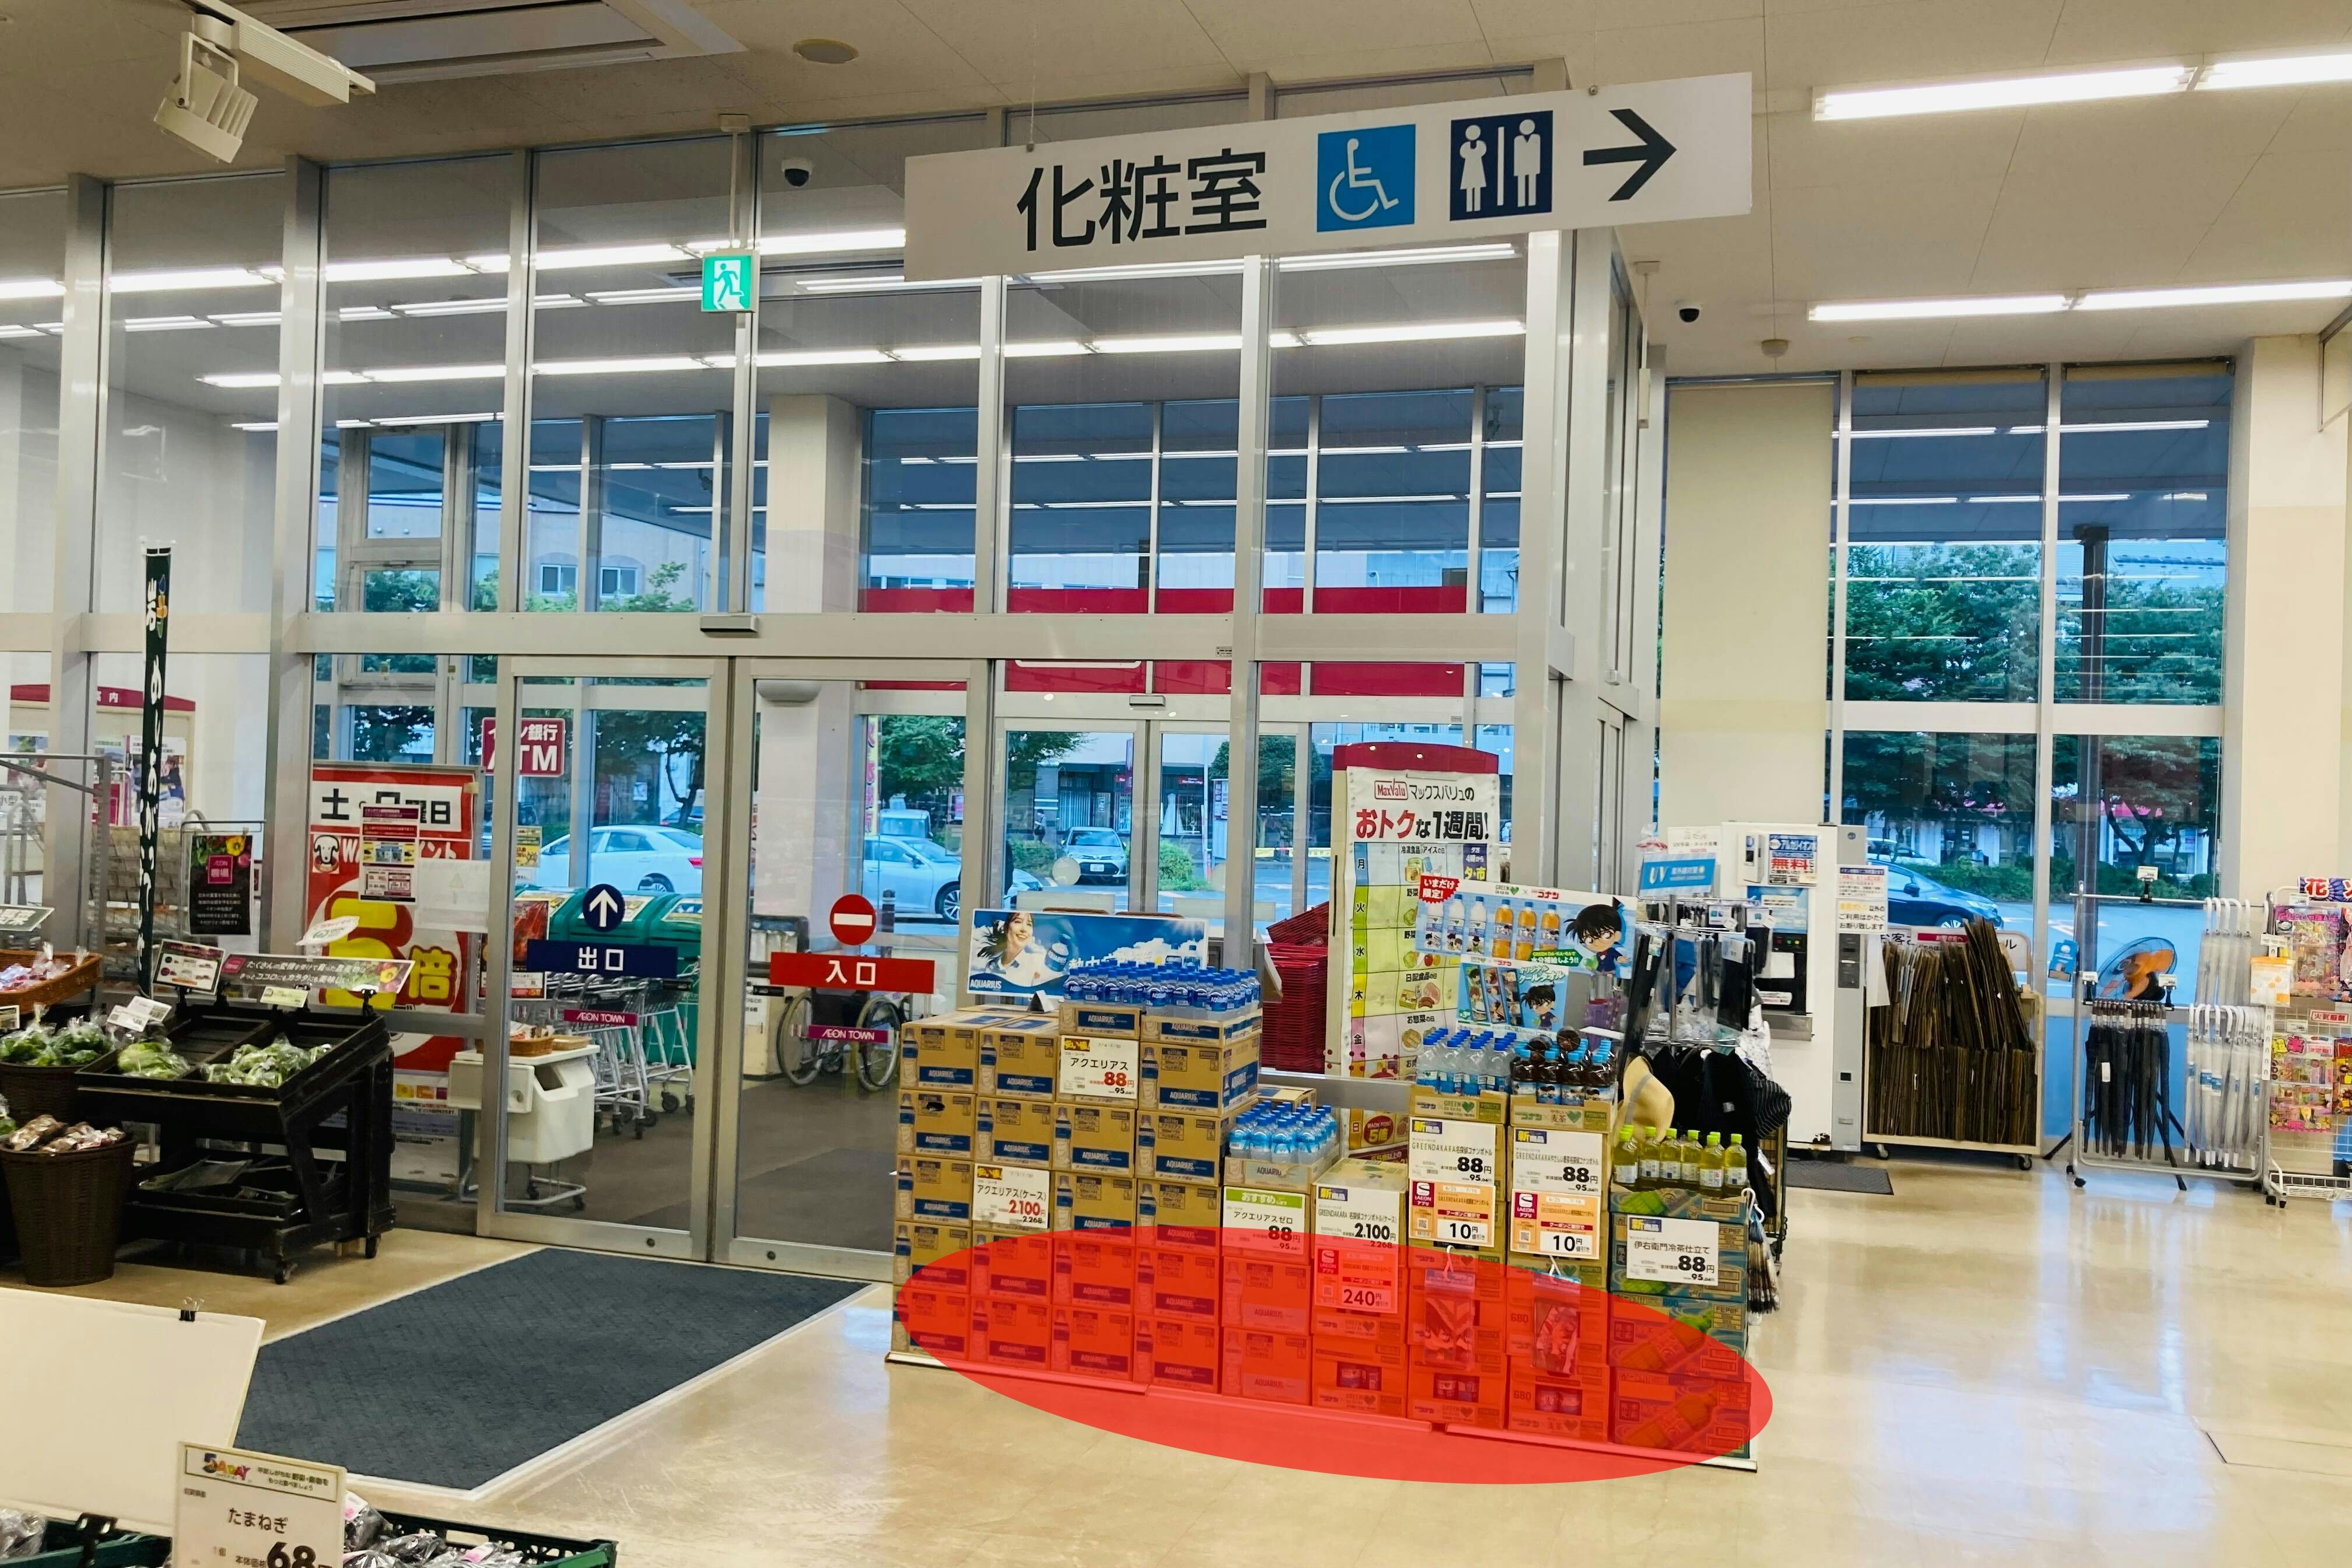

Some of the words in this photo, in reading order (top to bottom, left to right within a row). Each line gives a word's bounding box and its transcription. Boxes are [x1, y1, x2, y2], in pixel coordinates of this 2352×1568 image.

[1016, 148, 1267, 251] 化粧室
[1377, 778, 1406, 797] MaxValu
[1409, 785, 1475, 802] マックスバリュの
[1356, 808, 1489, 840] おトクな1週間!
[1357, 859, 1365, 869] 月
[1772, 859, 1808, 870] 無料
[1649, 866, 1668, 885] UV
[1424, 878, 1455, 890] いまだけ
[1422, 887, 1444, 900] 限定!
[1537, 891, 1559, 900] コナン
[1356, 903, 1365, 912] 火
[1838, 913, 1885, 921] ご利用はかたく
[1839, 922, 1884, 930] お断り致します
[1356, 946, 1364, 957] 水
[578, 947, 625, 971] 出口
[825, 960, 876, 986] 入口
[1518, 971, 1564, 984] クールタオル
[970, 978, 1002, 989] AQUARIUS
[1354, 990, 1363, 1000] 木
[601, 1013, 626, 1025] TOWN
[1087, 1014, 1115, 1025] AQUARIUS
[1171, 1023, 1199, 1032] AQUARIUS
[844, 1028, 876, 1041] TOWN
[1353, 1034, 1362, 1045] 金
[1070, 1058, 1129, 1071] アクエリアス
[929, 1069, 955, 1079] AQUARIUS
[1007, 1077, 1034, 1087] AQUARIUS
[1169, 1091, 1198, 1101] AQUARIUS
[1550, 1114, 1566, 1123] 麦茶
[926, 1136, 951, 1145] AQUARIUS
[1003, 1144, 1030, 1153] AQUARIUS
[1082, 1151, 1110, 1161] AQUARIUS
[1166, 1160, 1195, 1170] AQUARIUS
[977, 1185, 1046, 1201] アクエリアス(ケース)
[1241, 1192, 1276, 1204] おすすめ
[923, 1202, 950, 1212] AQUARIUS
[1234, 1211, 1293, 1224] アクエリアスゼロ
[1083, 1219, 1111, 1229] AQUARIUS
[1167, 1228, 1195, 1238] AQUARIUS
[1450, 1223, 1472, 1240] 10
[1553, 1235, 1576, 1252] 10
[1634, 1240, 1711, 1255] 伊右衛門冷茶仕立て
[1000, 1278, 1028, 1288] AQUARIUS
[1083, 1286, 1111, 1296] AQUARIUS
[1166, 1297, 1194, 1307] AQUARIUS
[1343, 1289, 1375, 1306] 240
[1254, 1308, 1283, 1318] AQUARIUS
[1510, 1313, 1529, 1323] 680
[1513, 1390, 1532, 1401] 680
[228, 1507, 289, 1534] たまねぎ
[267, 1541, 316, 1568] 68
